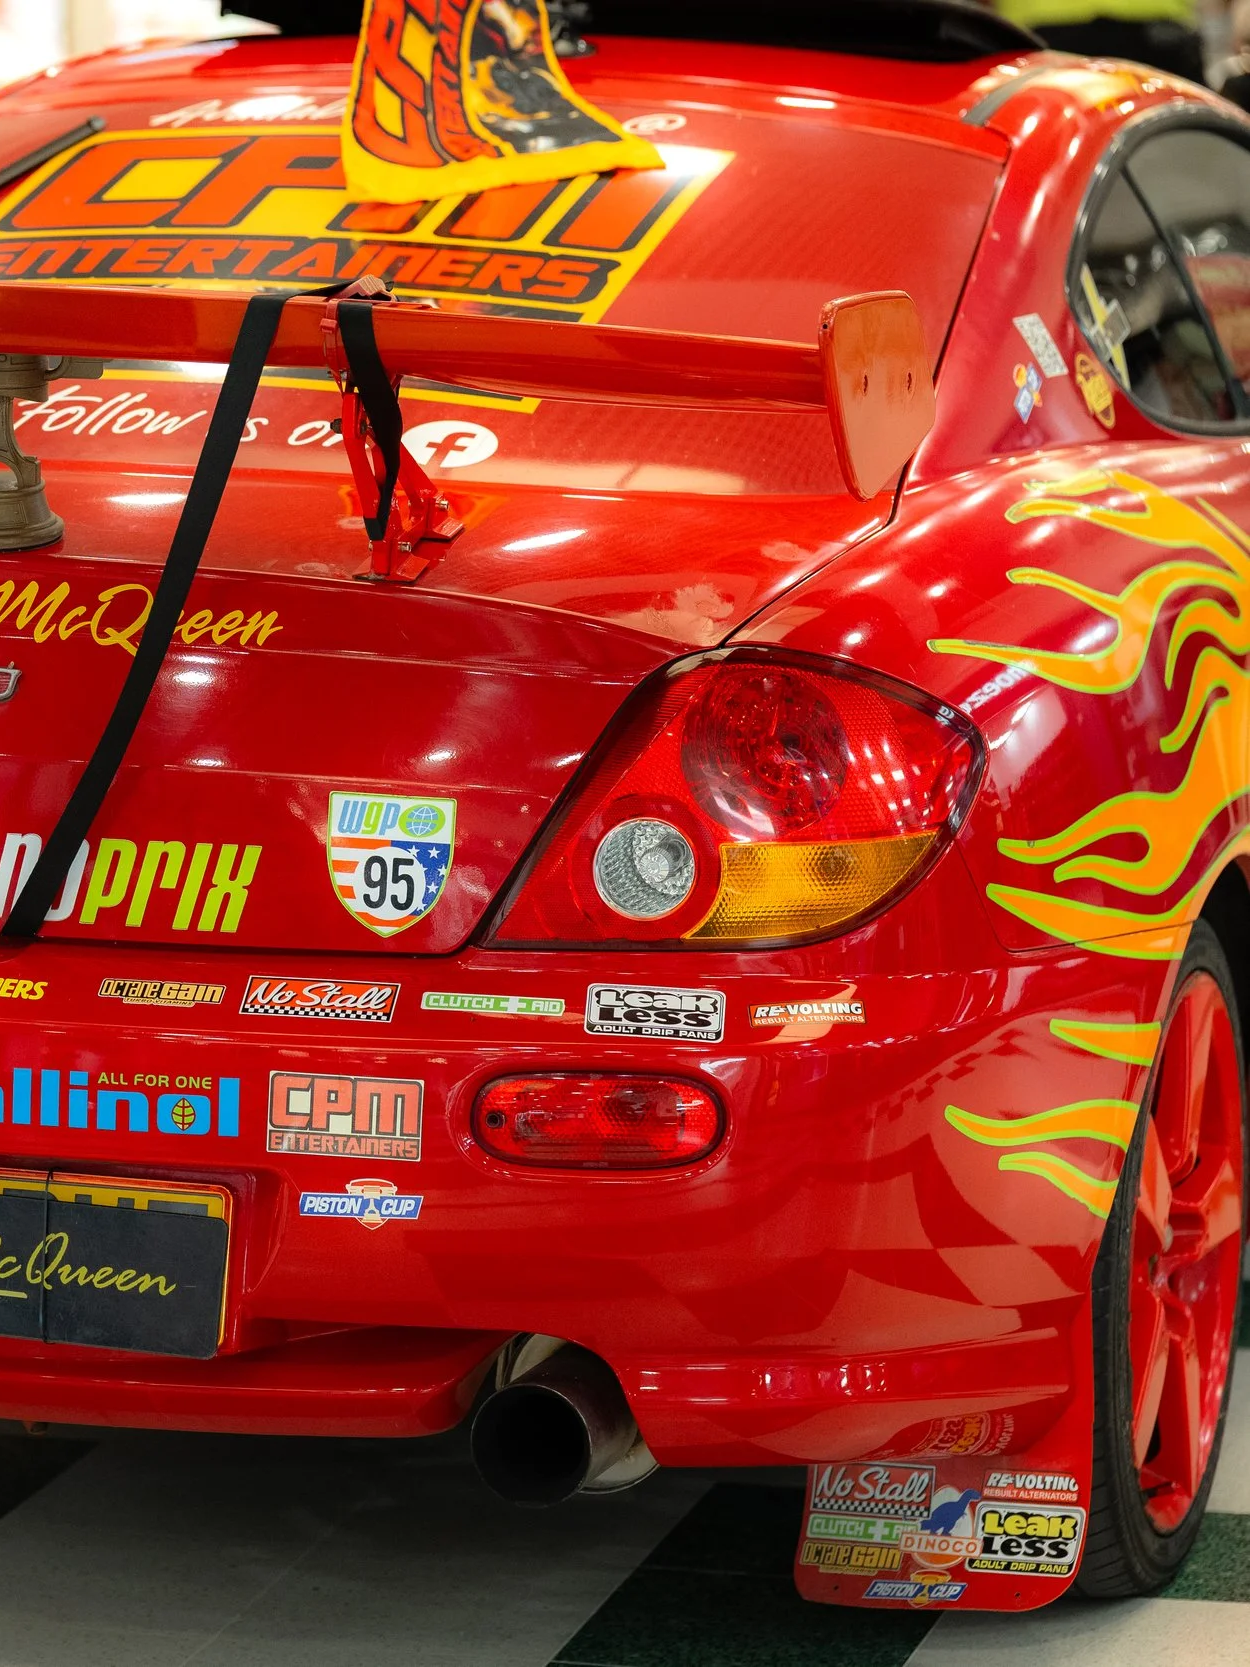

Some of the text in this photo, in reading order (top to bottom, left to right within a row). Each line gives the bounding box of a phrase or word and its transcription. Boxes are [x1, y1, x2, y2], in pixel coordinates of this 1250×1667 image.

[362, 855, 415, 911] 95
[248, 980, 396, 1010] No Stall
[429, 994, 560, 1013] CLUTCH AID
[596, 988, 718, 1014] Leak
[598, 1007, 712, 1028] Less
[754, 1015, 865, 1025] REBUILT ALTERNATORS
[593, 1025, 716, 1040] ADULT DRIP PANS
[97, 1072, 213, 1090] ALL FOR ONE
[272, 1074, 420, 1135] CPM
[270, 1132, 418, 1158] ENTERTAINERS
[303, 1196, 416, 1216] PISTON CUP
[816, 1464, 930, 1503] No Stall
[812, 1518, 865, 1535] CLUTCH
[982, 1510, 1078, 1540] Leak
[904, 1536, 978, 1553] DINOCO
[981, 1536, 1069, 1559] Less
[972, 1559, 1070, 1574] ADULT DRIP PANS
[869, 1582, 962, 1598] PISTON CUP
